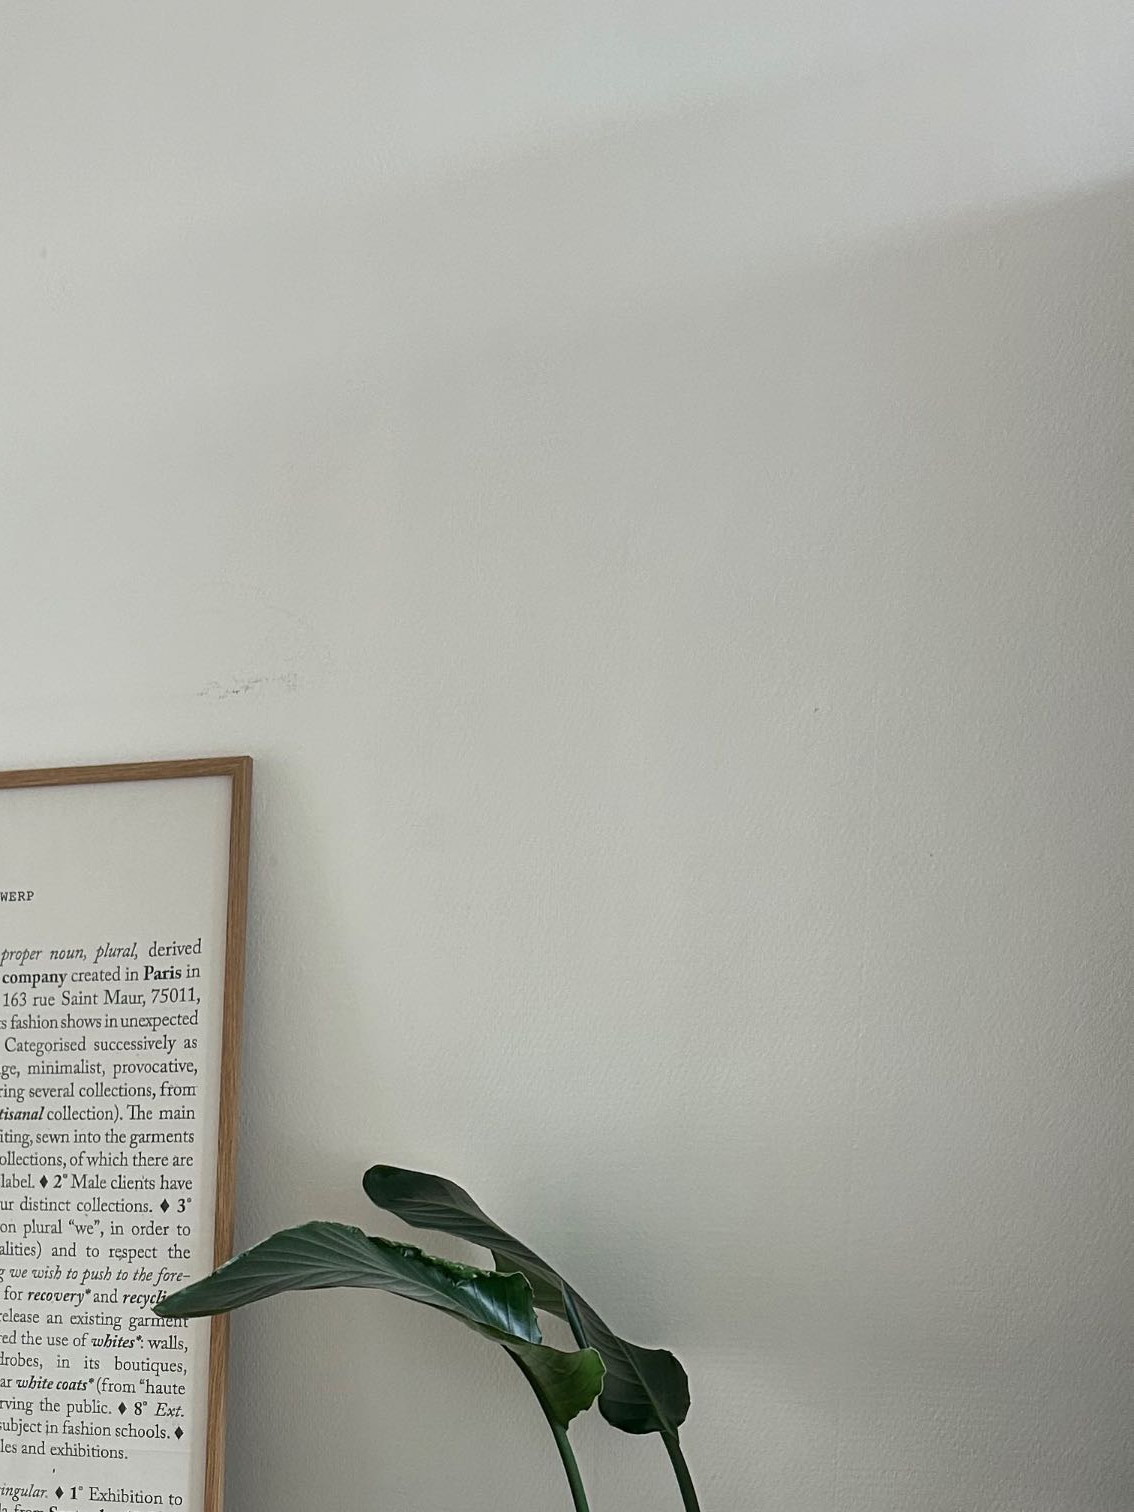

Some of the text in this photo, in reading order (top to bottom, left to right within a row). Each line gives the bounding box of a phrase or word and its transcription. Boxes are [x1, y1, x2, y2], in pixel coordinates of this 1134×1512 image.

[0, 947, 42, 964] proper
[49, 948, 87, 961] noun,
[95, 941, 138, 961] plural,
[148, 937, 202, 957] derived
[1, 972, 68, 987] company
[70, 965, 121, 982] created
[124, 967, 139, 981] in
[143, 964, 182, 980] Paris
[185, 964, 201, 978] in
[2, 992, 27, 1006] 163
[32, 996, 55, 1006] rue
[61, 990, 98, 1005] Saint
[103, 988, 146, 1007] Maur,
[150, 986, 201, 1005] 75011,
[4, 1035, 87, 1056] Categorised
[93, 1034, 177, 1055] successively
[183, 1039, 197, 1048] as
[27, 1058, 106, 1077] minimalist,
[112, 1058, 198, 1077] provocative,
[46, 1104, 123, 1122] collection).
[125, 1104, 153, 1120] The
[158, 1105, 195, 1119] main
[19, 1195, 71, 1211] distinct
[76, 1196, 153, 1212] collections.
[22, 1218, 62, 1237] plural
[110, 1221, 124, 1235] in
[131, 1220, 170, 1236] order
[176, 1224, 191, 1235] to
[51, 1241, 77, 1256] and
[85, 1246, 100, 1257] to
[108, 1246, 158, 1262] respect
[167, 1243, 191, 1259] the
[56, 1355, 71, 1368] in
[83, 1355, 100, 1369] its
[113, 1356, 187, 1377] boutiques,
[38, 1396, 60, 1412] the
[66, 1397, 112, 1418] public.
[153, 1402, 184, 1417] Ext.
[20, 1439, 46, 1455] and
[49, 1441, 128, 1459] exhibitions.
[88, 1486, 164, 1505] Exhibition
[168, 1494, 183, 1506] to
